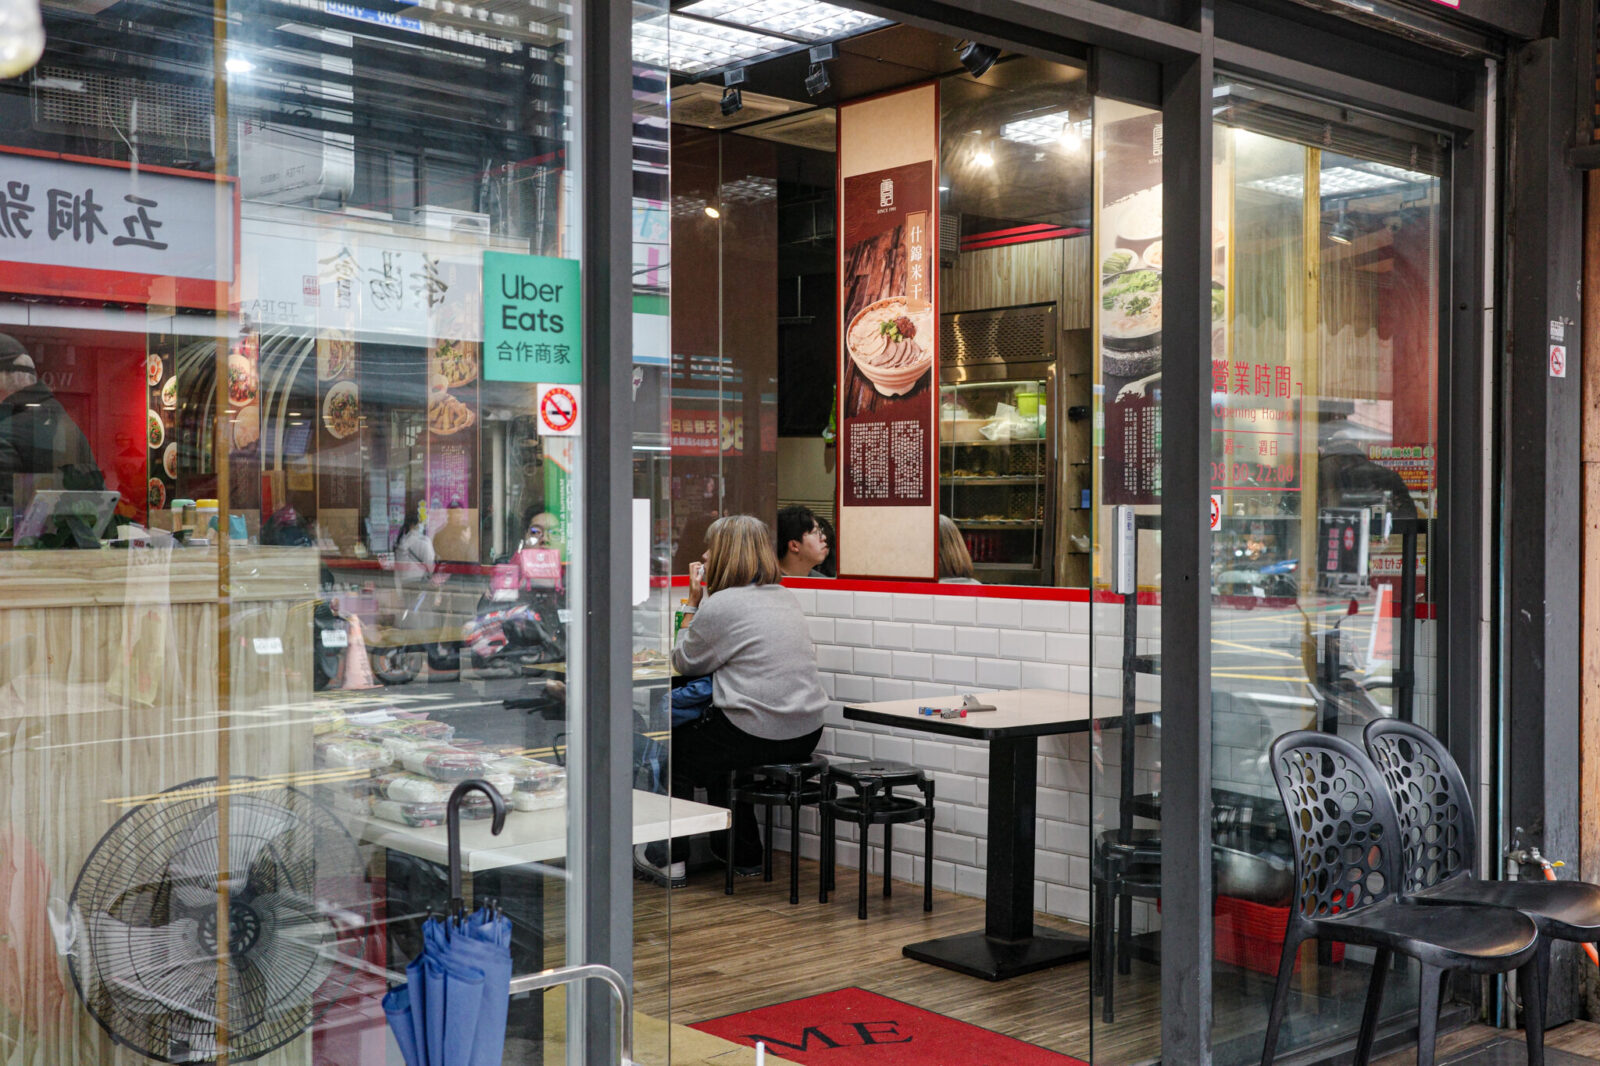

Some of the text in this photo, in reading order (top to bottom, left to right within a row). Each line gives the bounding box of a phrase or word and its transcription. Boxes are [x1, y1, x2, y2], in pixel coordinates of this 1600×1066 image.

[501, 273, 564, 303] Uber
[502, 304, 564, 334] Eats
[496, 340, 571, 365] 合作商家
[1211, 359, 1291, 399] 營業時間
[1213, 402, 1293, 423] Opening Hours
[1258, 440, 1279, 456] 週日
